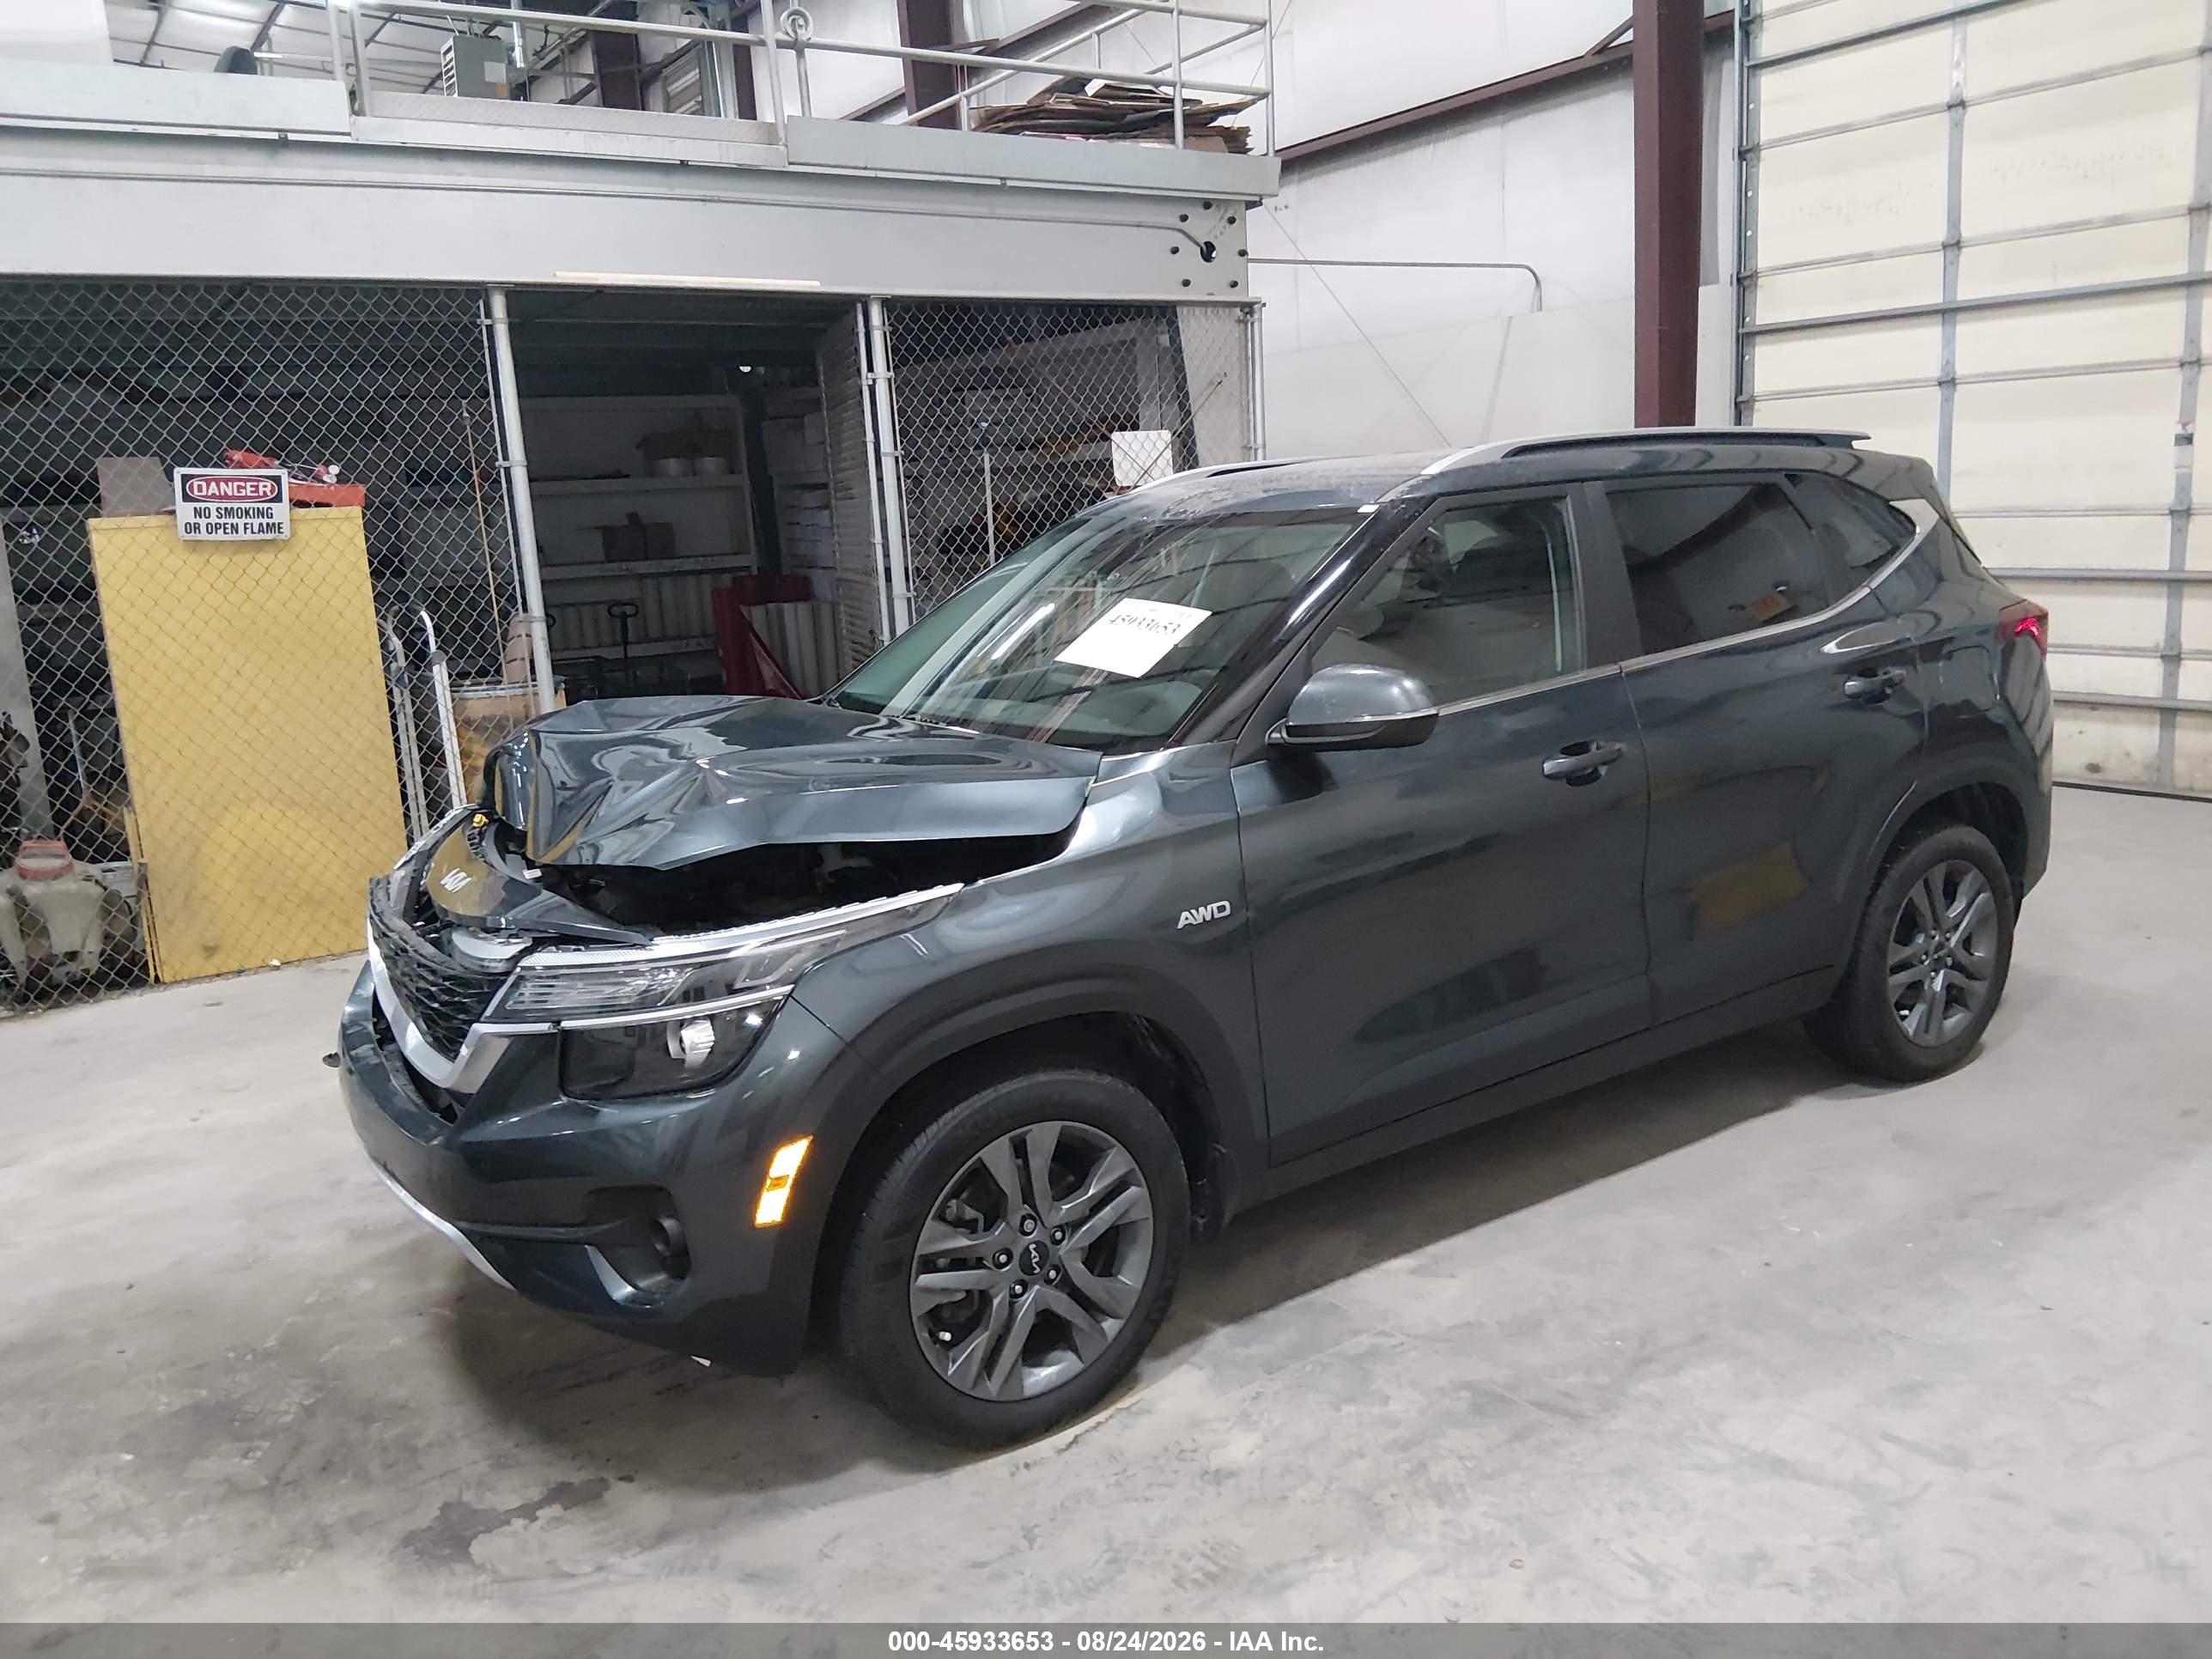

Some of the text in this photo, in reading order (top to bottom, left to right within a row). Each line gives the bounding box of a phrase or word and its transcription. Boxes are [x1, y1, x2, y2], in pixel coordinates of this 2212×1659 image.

[192, 481, 272, 496] DANGER
[193, 507, 274, 519] NO SMOKING
[184, 522, 284, 535] OR OPEN FLAME
[1177, 900, 1231, 929] AWD
